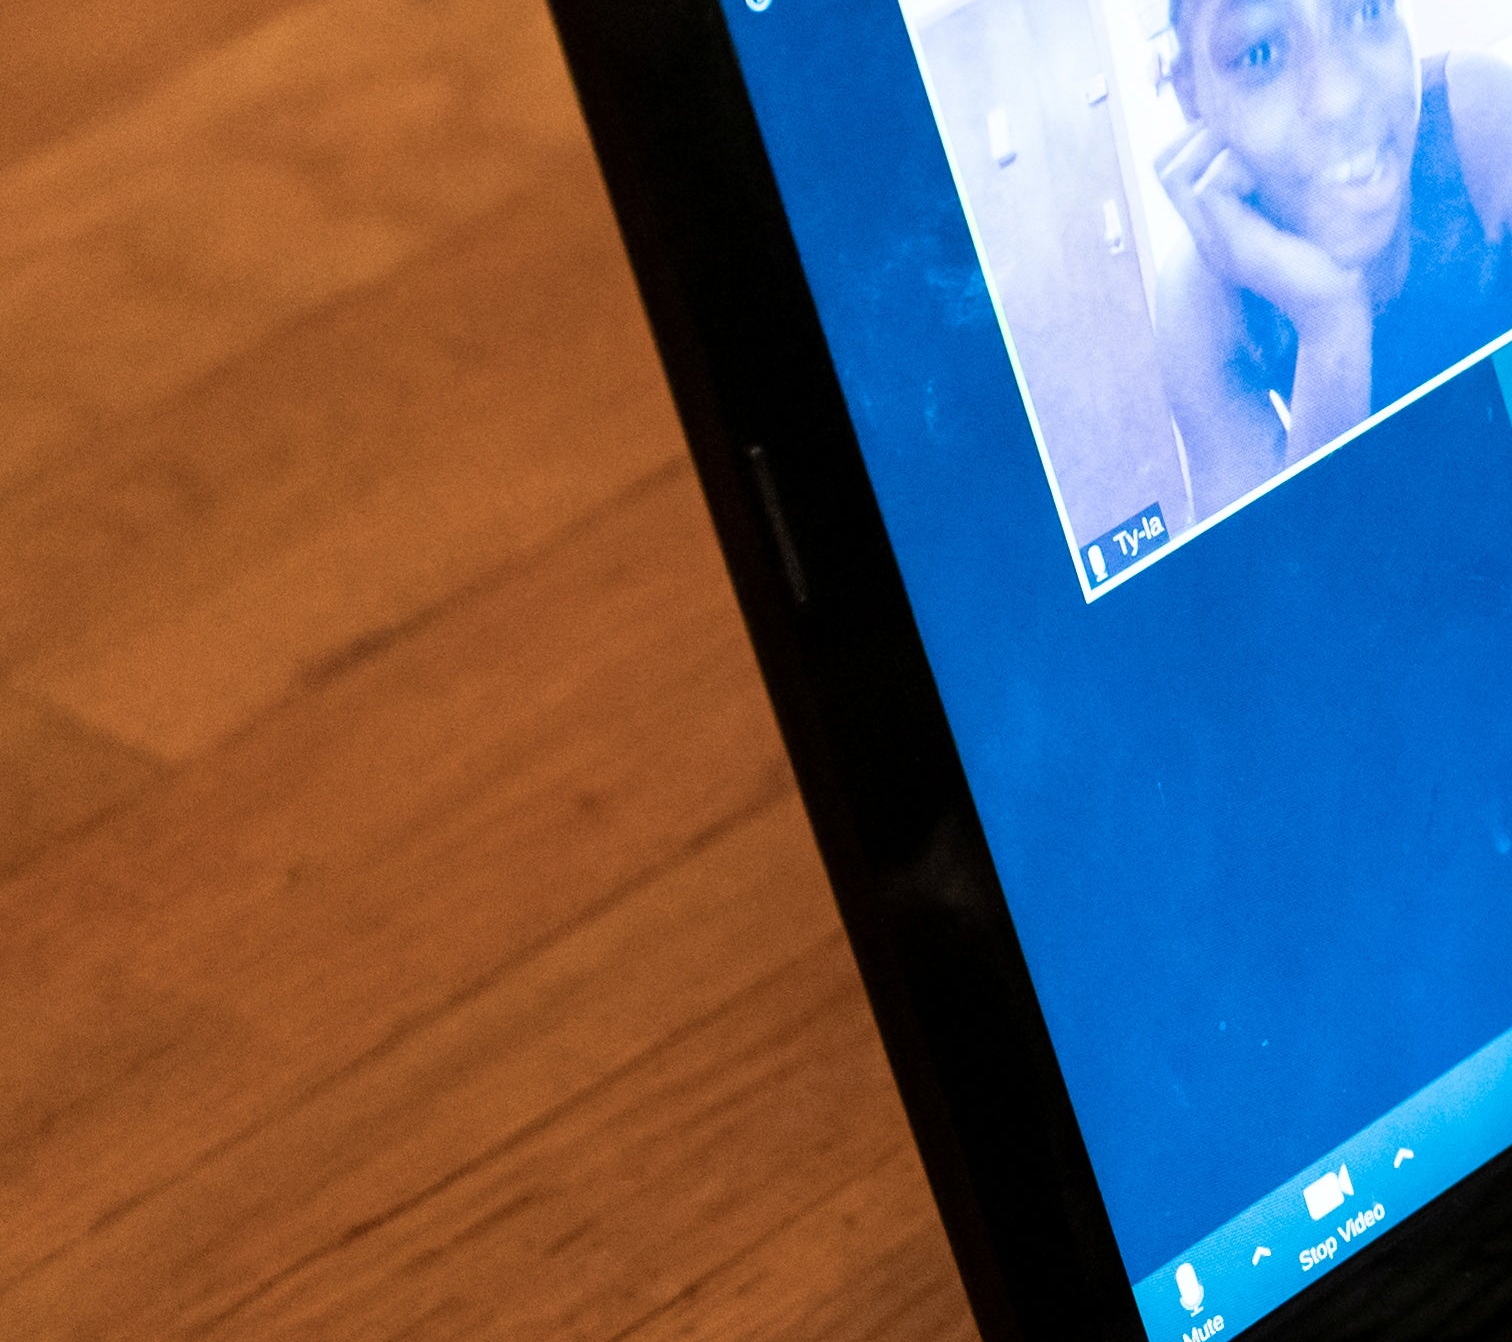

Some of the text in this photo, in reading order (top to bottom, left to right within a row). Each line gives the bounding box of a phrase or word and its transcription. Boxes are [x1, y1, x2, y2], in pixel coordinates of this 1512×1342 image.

[1112, 515, 1165, 557] Ty-la
[1299, 1203, 1386, 1272] Stop Video
